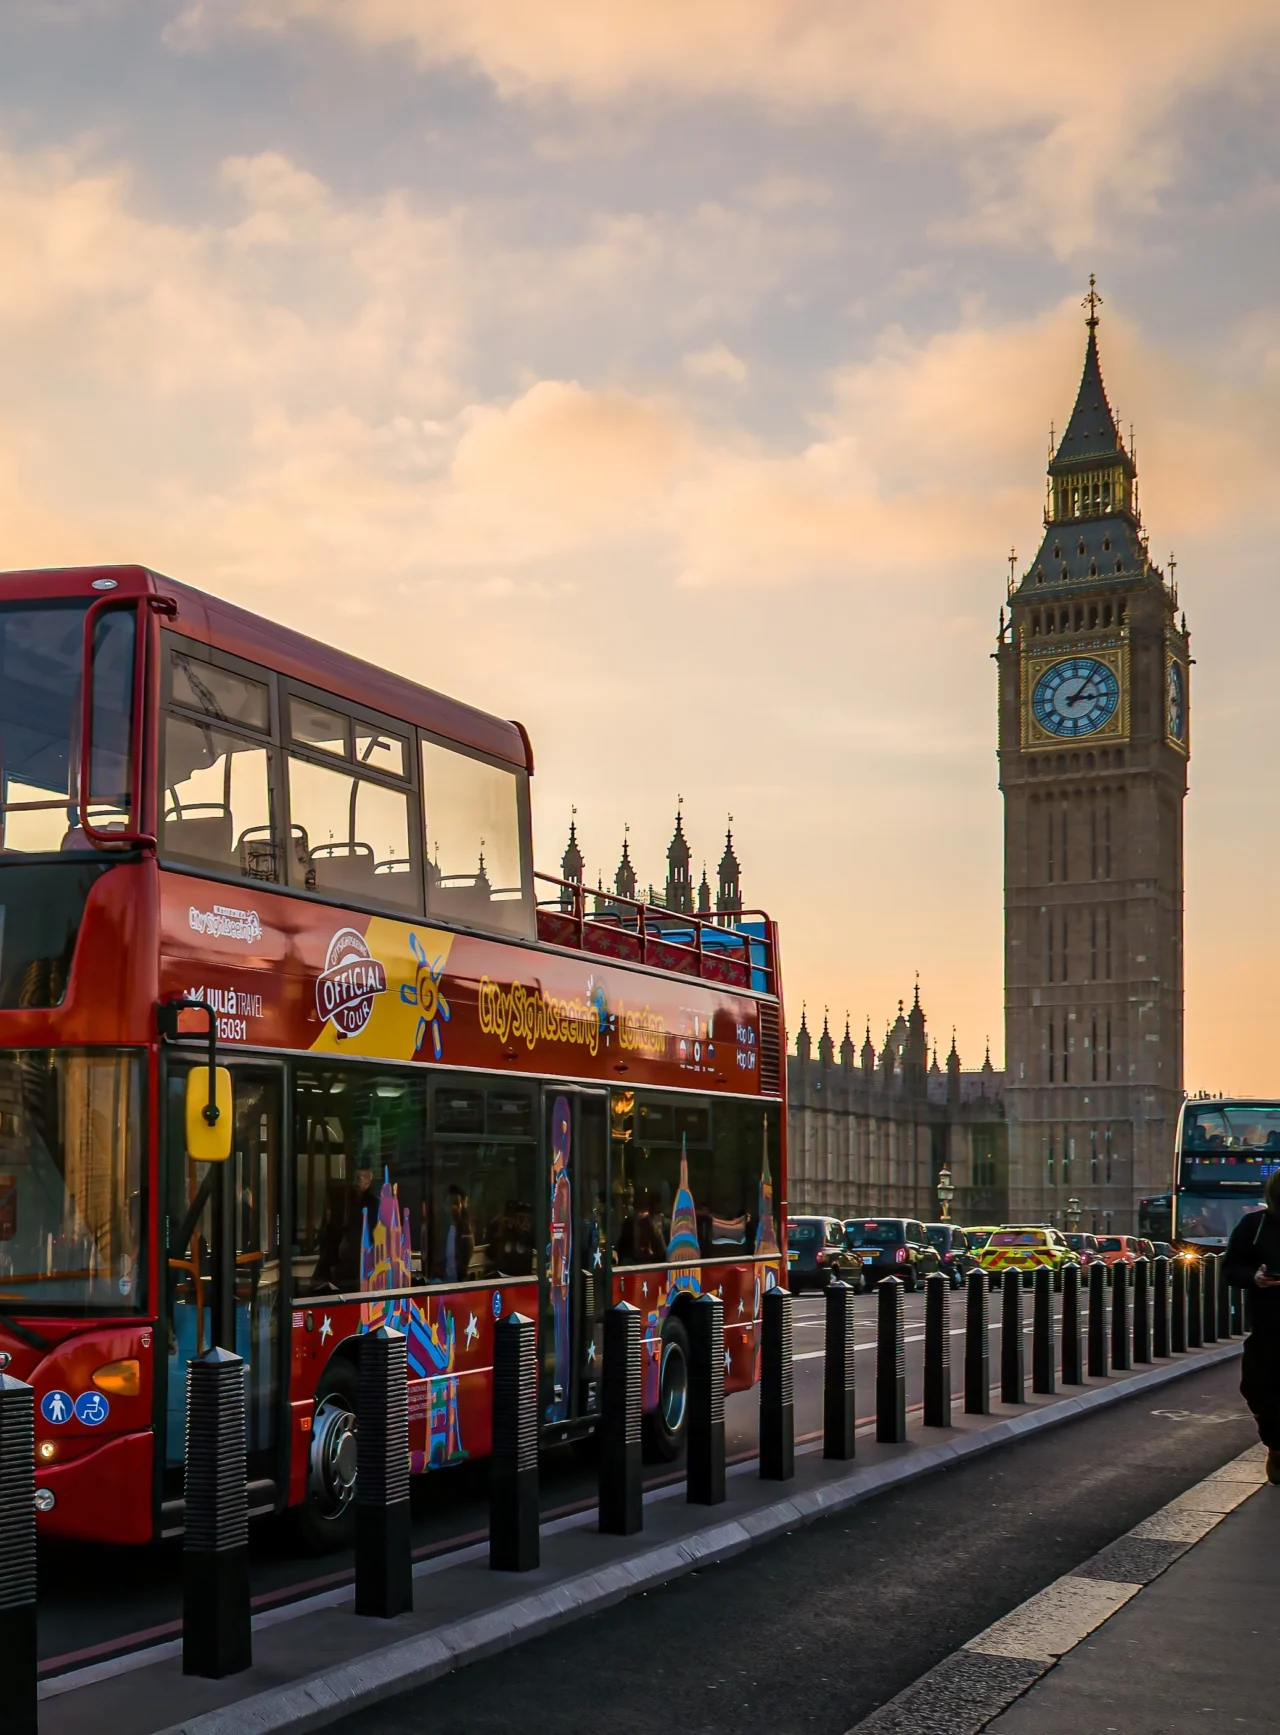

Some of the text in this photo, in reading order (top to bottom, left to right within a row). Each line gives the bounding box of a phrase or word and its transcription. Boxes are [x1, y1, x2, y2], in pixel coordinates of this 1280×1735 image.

[323, 965, 383, 1010] OFFICIAL
[237, 992, 264, 1018] TRAVEL
[343, 1001, 370, 1029] TOUR
[478, 975, 600, 1057] CitySightseeing
[215, 1017, 247, 1040] 15031
[619, 999, 666, 1053] London
[736, 1023, 755, 1045] Hop On
[736, 1048, 756, 1070] Hop Off
